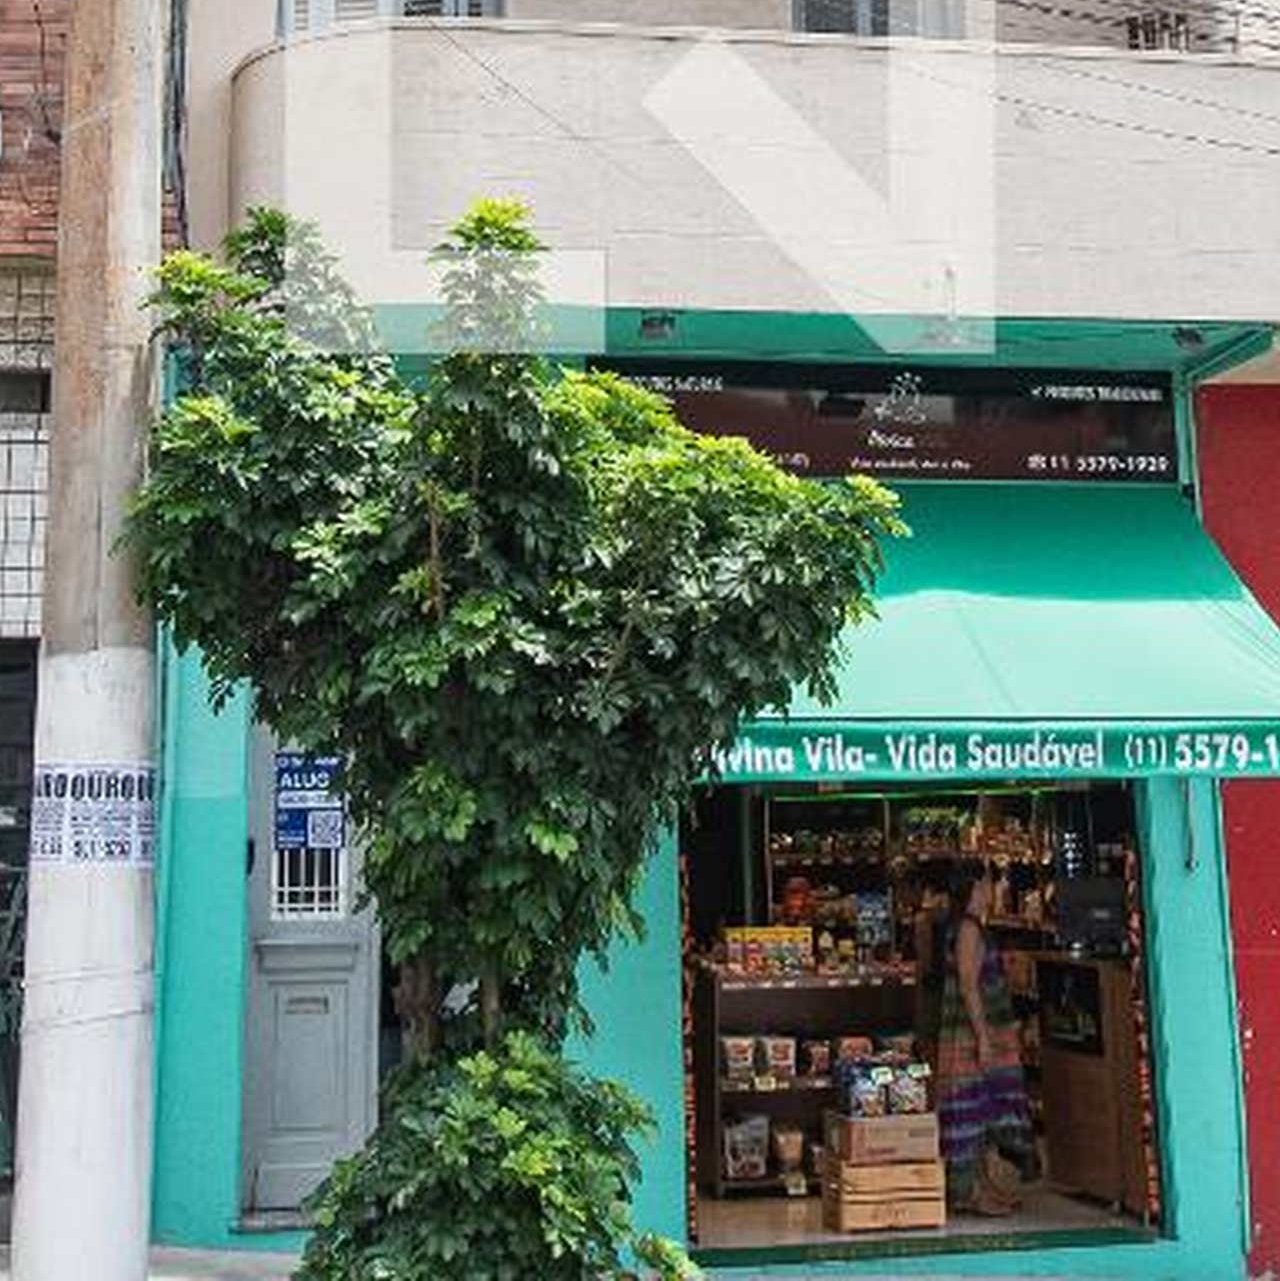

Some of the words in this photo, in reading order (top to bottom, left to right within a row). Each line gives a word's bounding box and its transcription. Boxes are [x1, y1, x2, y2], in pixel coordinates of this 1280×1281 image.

[885, 734, 957, 772] Vida
[967, 728, 1103, 770] Saudável
[1124, 733, 1167, 769] (11)
